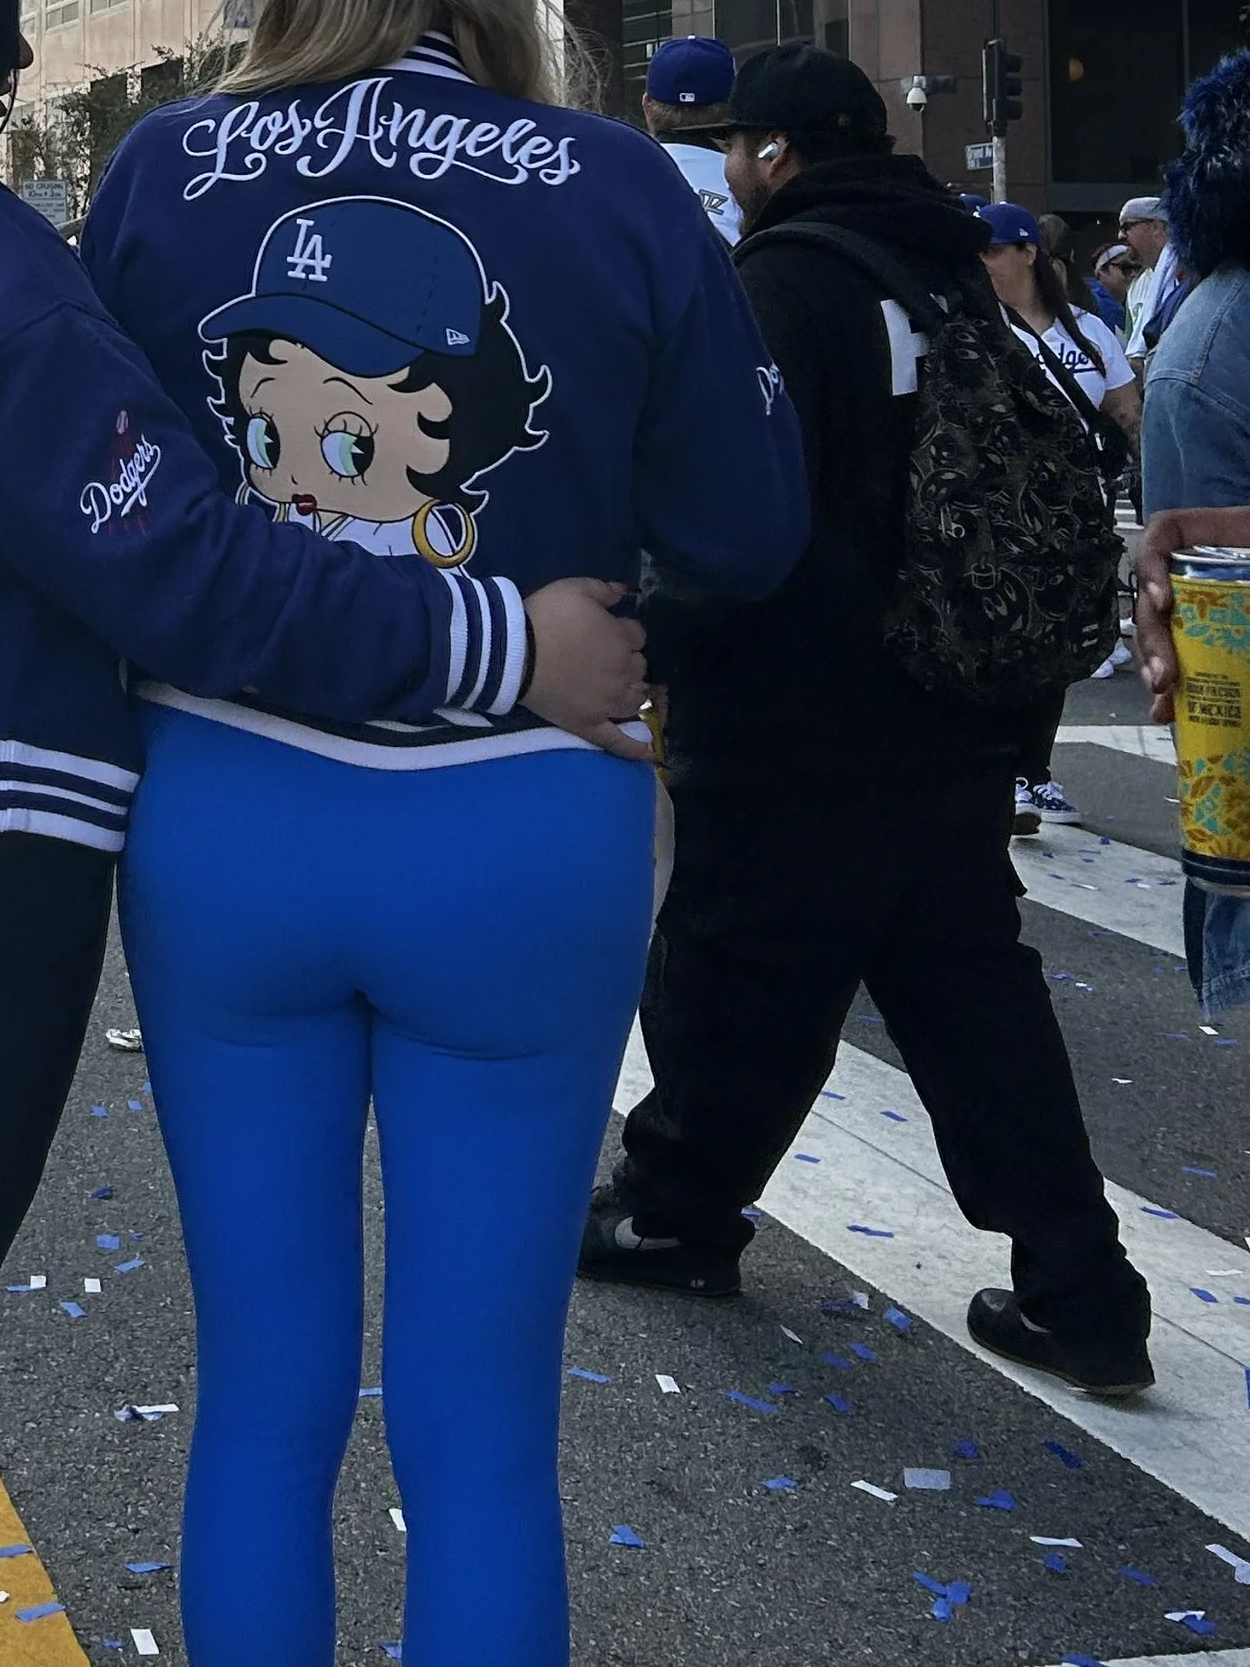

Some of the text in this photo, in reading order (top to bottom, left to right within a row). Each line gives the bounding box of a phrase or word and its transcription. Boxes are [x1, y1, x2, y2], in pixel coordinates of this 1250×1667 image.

[182, 76, 581, 201] Los Angeles
[286, 218, 333, 282] LA
[79, 433, 161, 534] Dodgers
